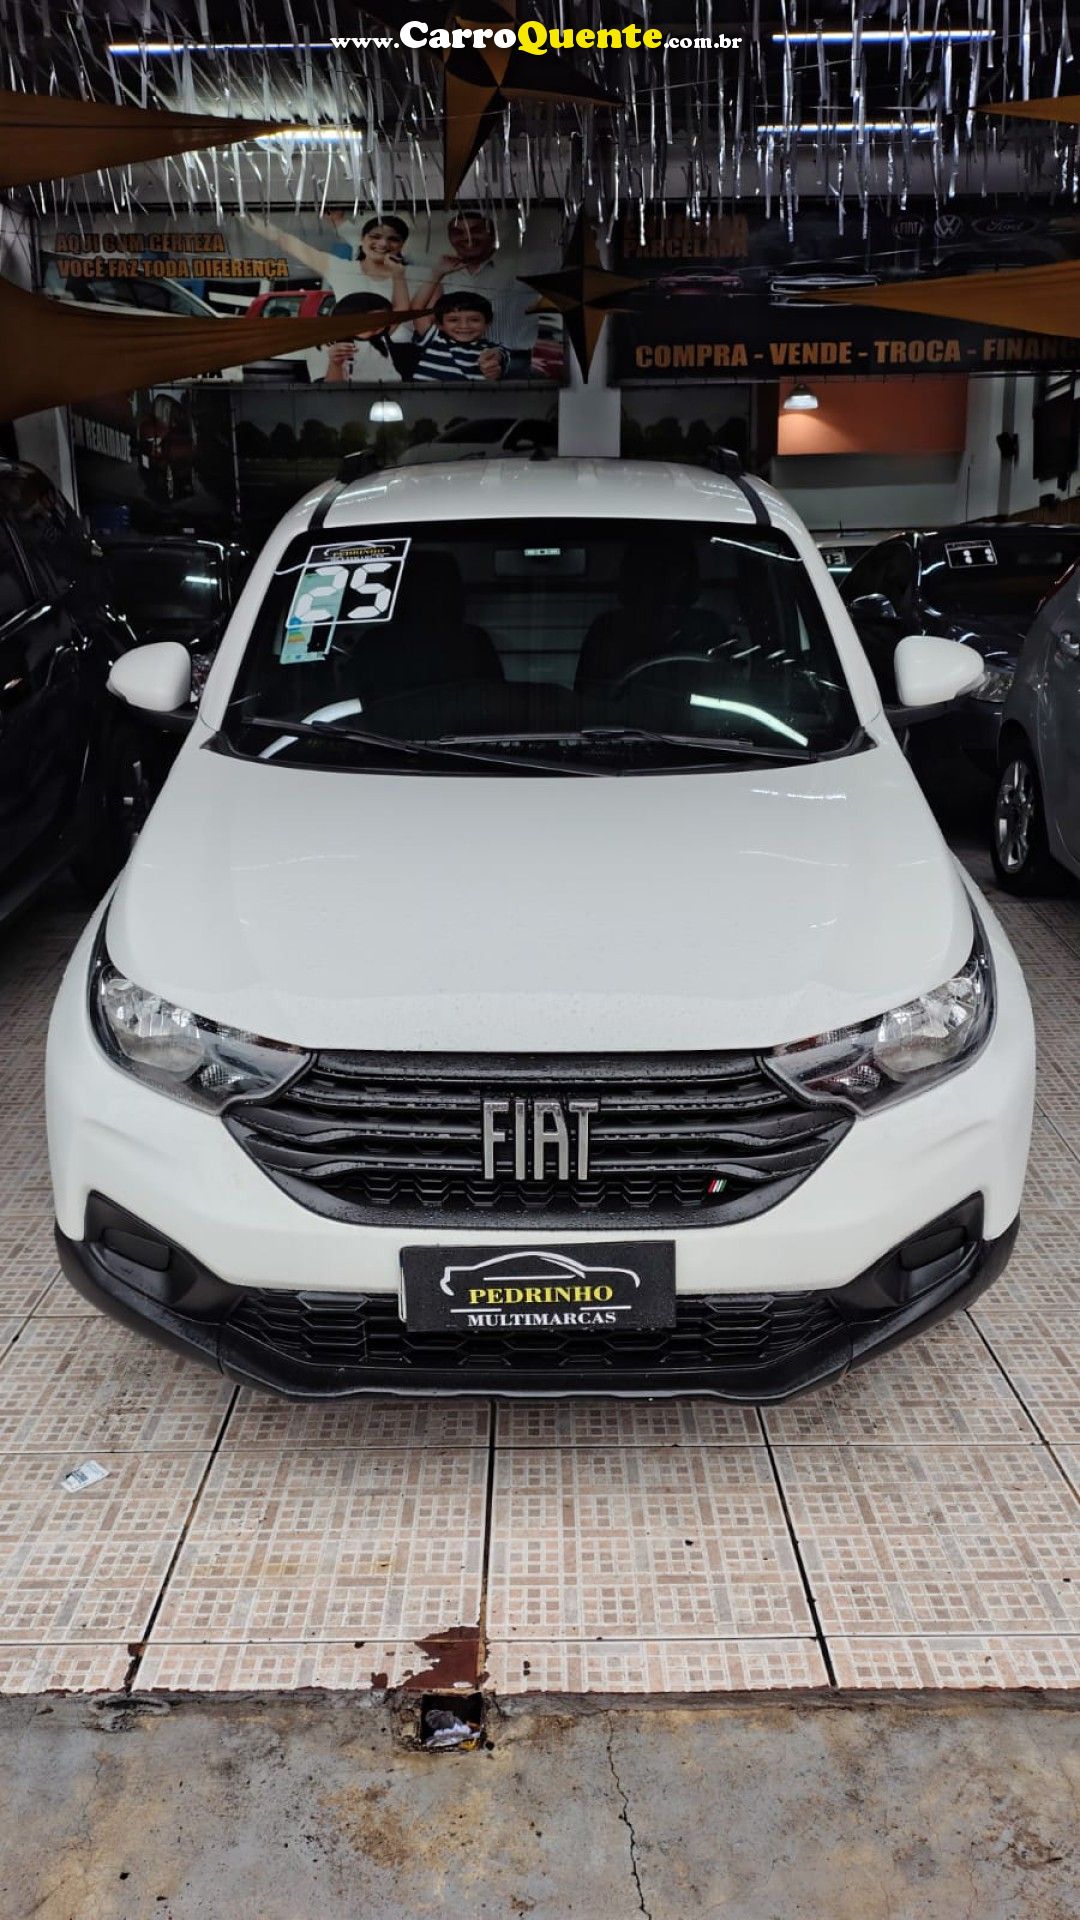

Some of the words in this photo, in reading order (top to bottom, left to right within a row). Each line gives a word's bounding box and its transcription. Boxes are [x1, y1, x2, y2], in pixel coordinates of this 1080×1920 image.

[55, 232, 100, 254] AQUI
[148, 232, 225, 253] CERTEZA
[58, 255, 107, 278] VOCÊ
[108, 258, 140, 278] FAZ
[142, 258, 189, 278] TODA
[191, 257, 289, 280] DIFERENÇA
[635, 343, 748, 368] COMPRA
[768, 341, 852, 366] VENDE
[873, 339, 961, 364] TROCA
[294, 562, 392, 622] 25
[483, 1098, 599, 1181] FIAT
[468, 1285, 613, 1304] PEDRINHO
[467, 1311, 617, 1327] MULTIMARCAS
